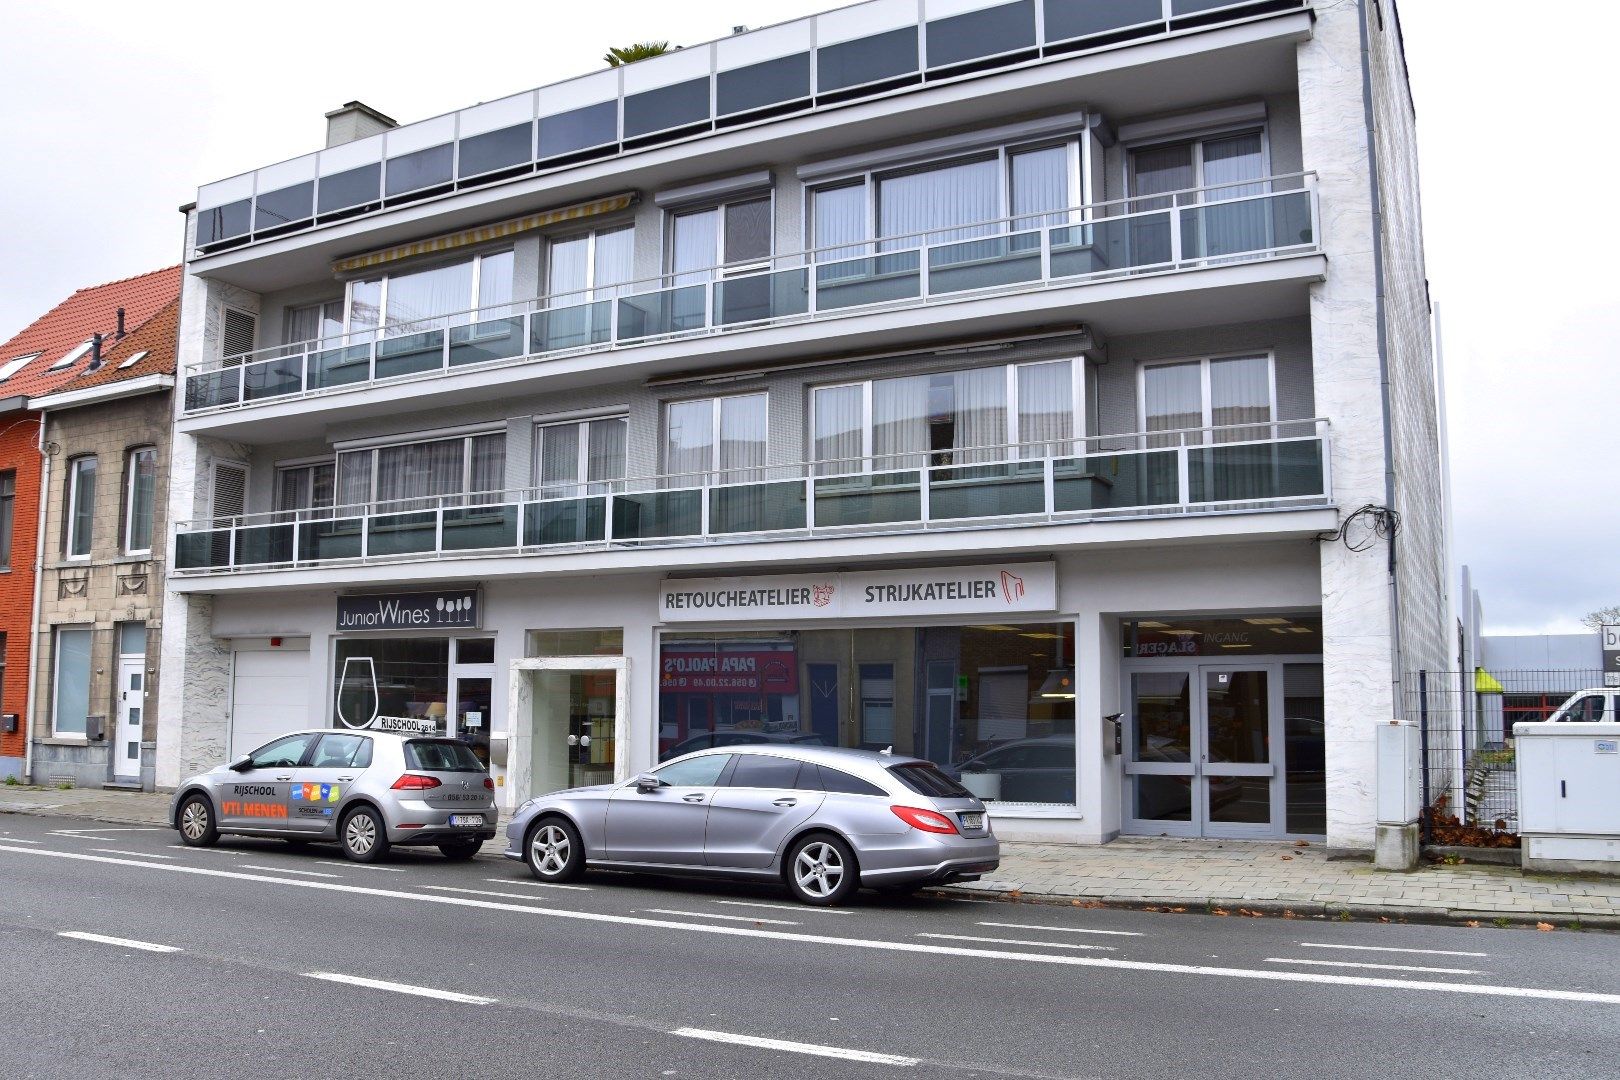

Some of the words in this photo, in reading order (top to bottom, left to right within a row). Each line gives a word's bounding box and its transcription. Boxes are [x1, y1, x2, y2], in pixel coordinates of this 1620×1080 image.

[665, 587, 811, 609] RETOUCHEATELIER
[865, 580, 996, 603] STRIJKATELIER
[1203, 632, 1249, 643] INGANG
[381, 718, 421, 731] RIJSCHOOL
[233, 785, 276, 797] RIJSCHOOL
[222, 801, 241, 816] VTI
[243, 802, 287, 819] MENEN
